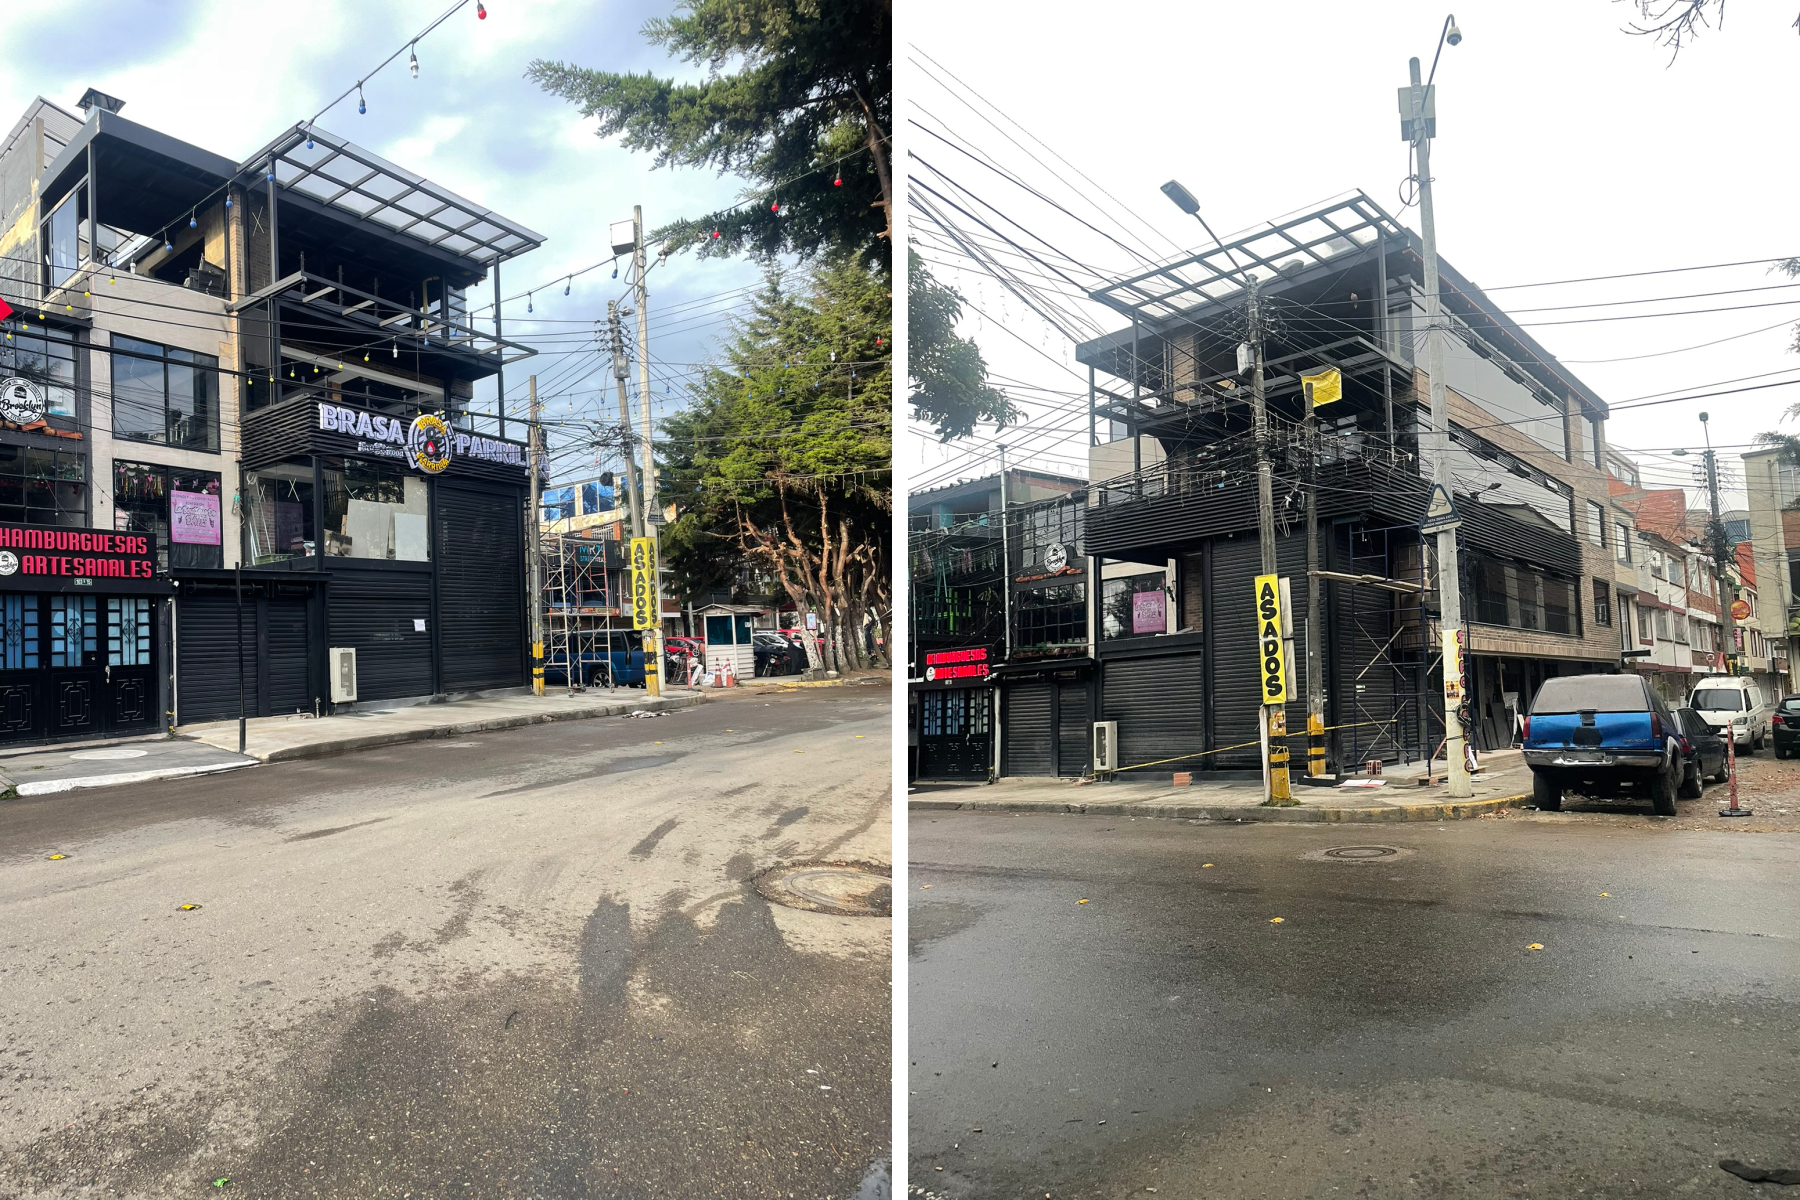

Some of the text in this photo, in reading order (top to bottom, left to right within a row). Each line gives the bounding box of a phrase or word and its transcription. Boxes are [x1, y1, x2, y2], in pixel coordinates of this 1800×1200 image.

[0, 398, 42, 414] Brooklyn
[318, 403, 405, 445] BRASA
[416, 415, 448, 435] BRASA
[0, 527, 147, 554] HAMBURGUESAS
[22, 555, 152, 578] ARTESANALES
[649, 542, 657, 624] ASADOS
[634, 543, 648, 625] ASADOS
[1260, 582, 1283, 697] ASADOS
